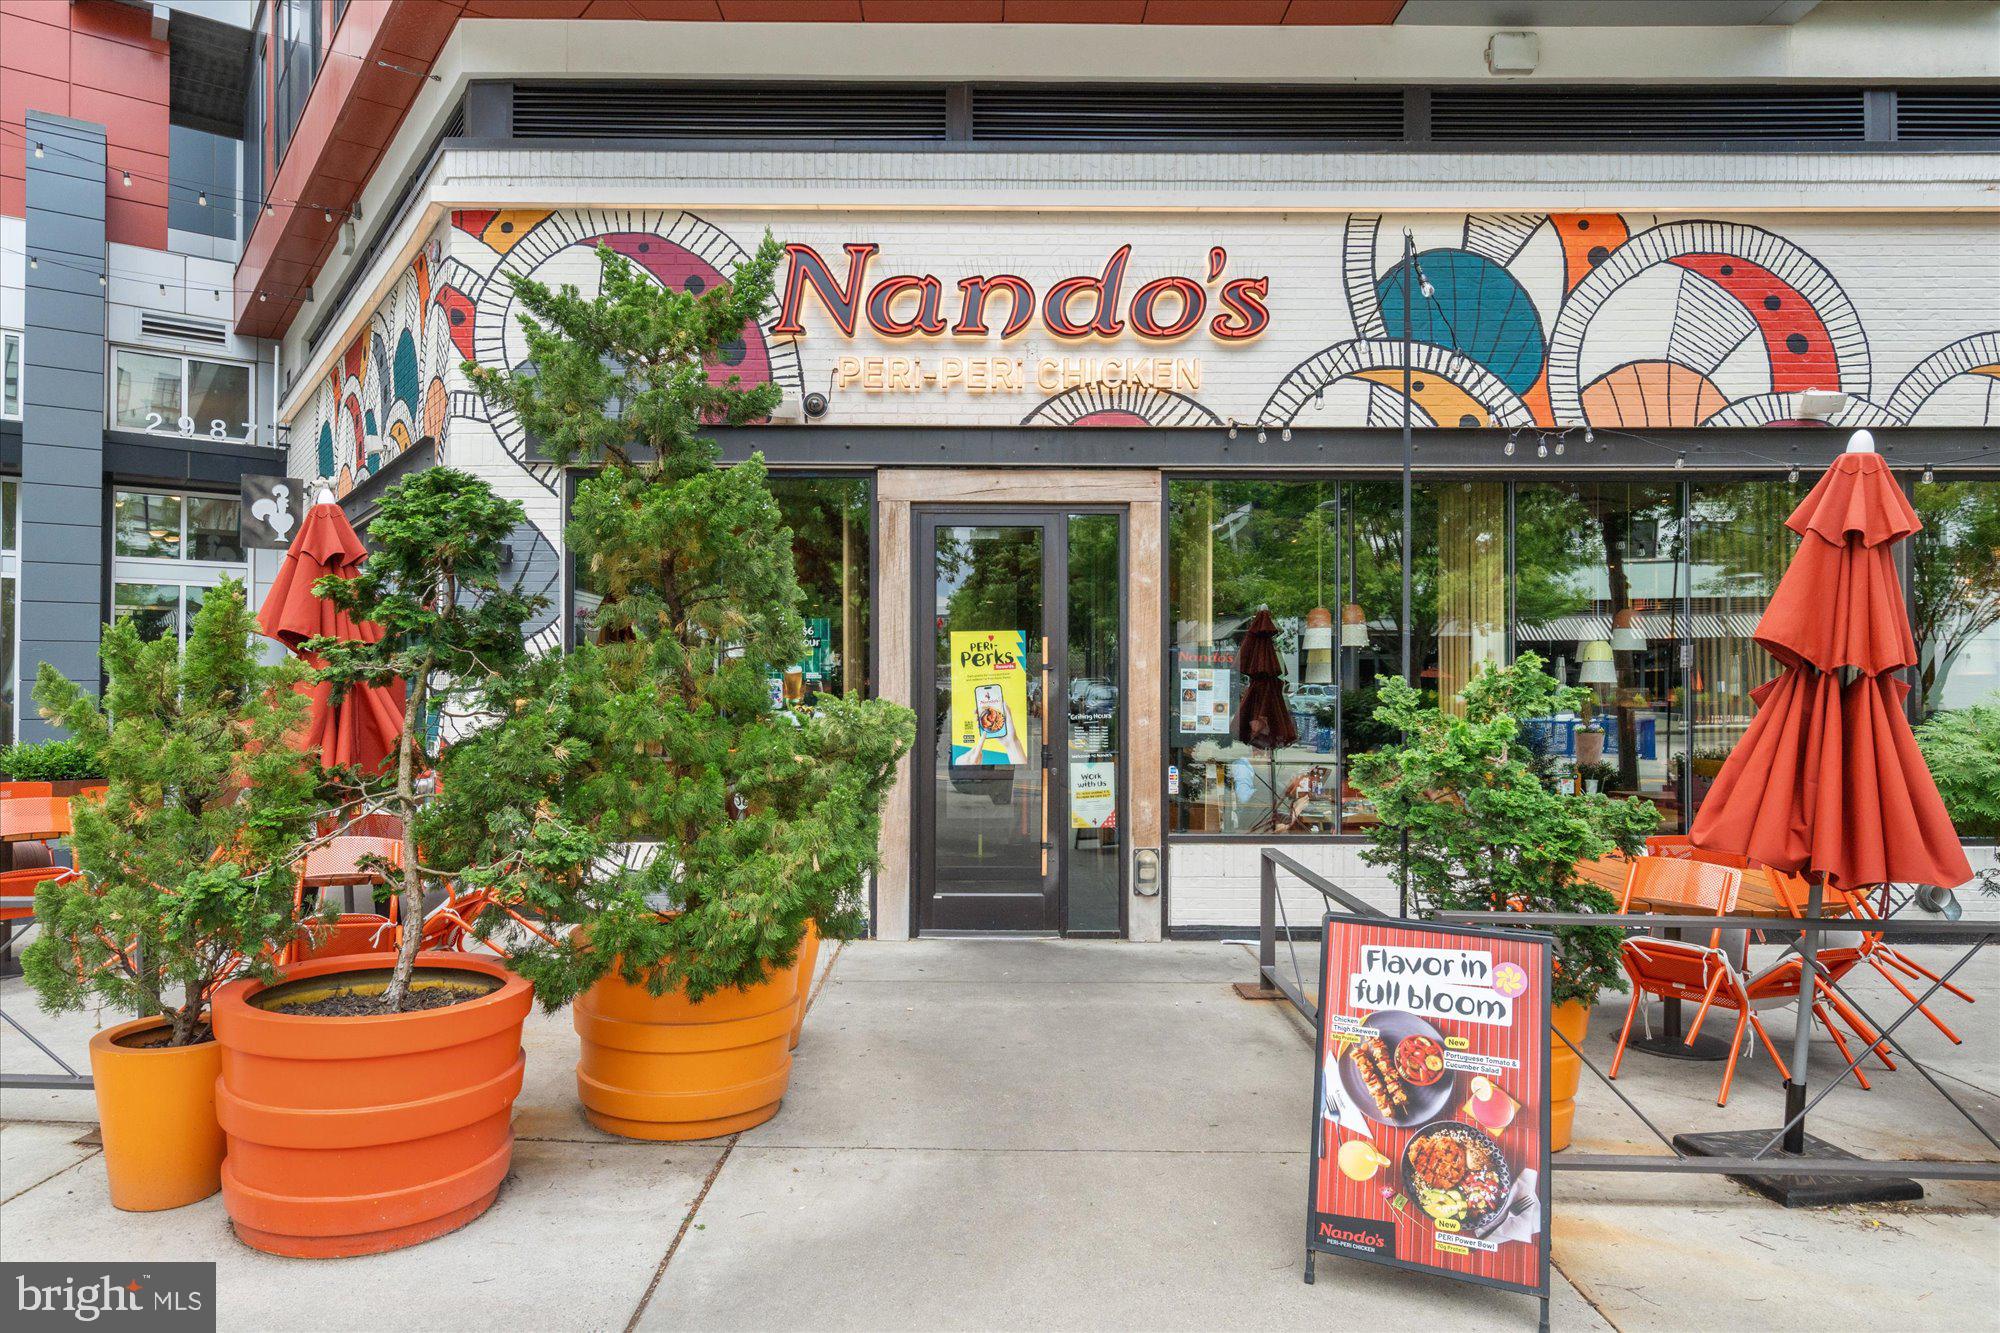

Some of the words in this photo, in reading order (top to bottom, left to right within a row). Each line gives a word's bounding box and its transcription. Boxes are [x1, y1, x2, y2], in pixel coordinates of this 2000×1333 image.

[768, 242, 1271, 339] Nando's
[1037, 357, 1202, 391] CHICKEN
[145, 412, 258, 445] 2987
[960, 649, 1014, 668] Perks
[1077, 780, 1096, 788] with
[1367, 949, 1454, 977] Flavor
[1461, 953, 1487, 979] in
[1355, 979, 1400, 1006] full
[1408, 984, 1506, 1020] bloom
[1333, 1015, 1359, 1024] Chicken
[1333, 1024, 1351, 1032] Thigh
[1351, 1026, 1378, 1036] Skewers
[1445, 1051, 1484, 1063] Portuguese
[1486, 1057, 1511, 1066] Tomato
[1445, 1060, 1480, 1072] Cucumber
[1480, 1065, 1500, 1074] Salad
[1438, 1220, 1457, 1229] New
[1318, 1222, 1385, 1247] Nando's
[1352, 1243, 1376, 1253] CHICKEN
[1454, 1236, 1477, 1246] Power
[1477, 1240, 1495, 1250] Bowl
